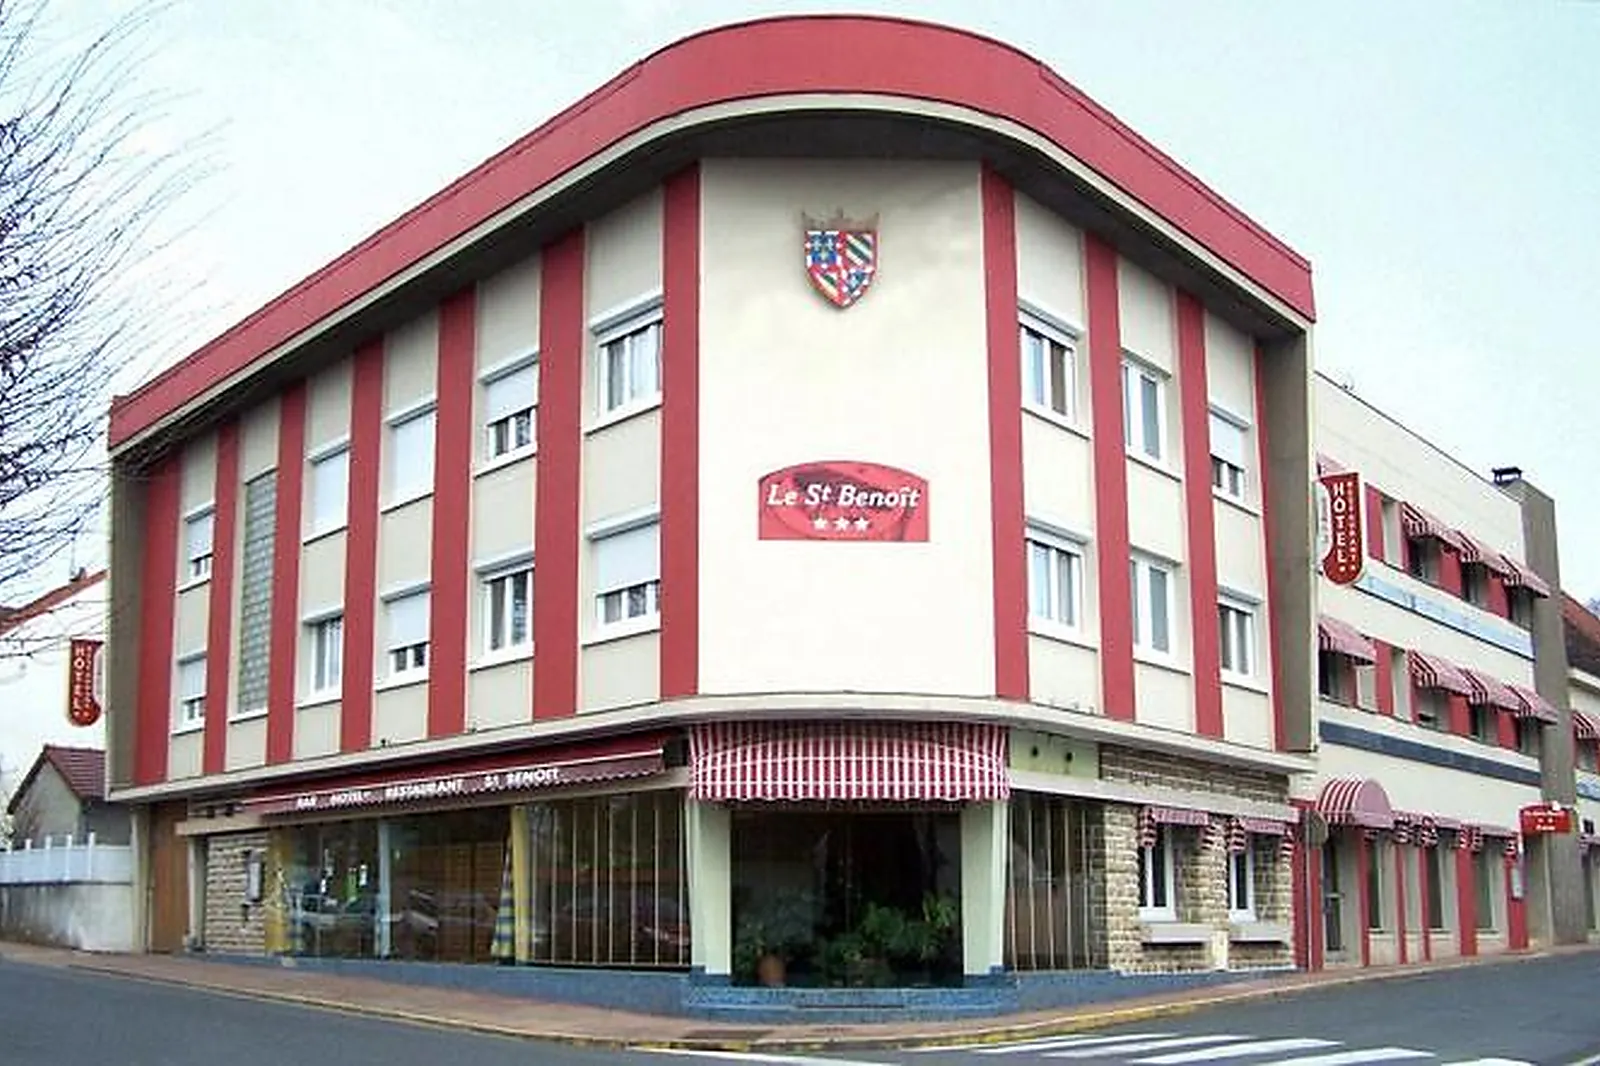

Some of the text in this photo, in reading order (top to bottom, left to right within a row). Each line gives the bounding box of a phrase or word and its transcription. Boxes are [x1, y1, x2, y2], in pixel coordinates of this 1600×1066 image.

[767, 484, 921, 508] Le St Benoît
[1334, 482, 1347, 563] HOTEL
[74, 647, 85, 709] HOTEL
